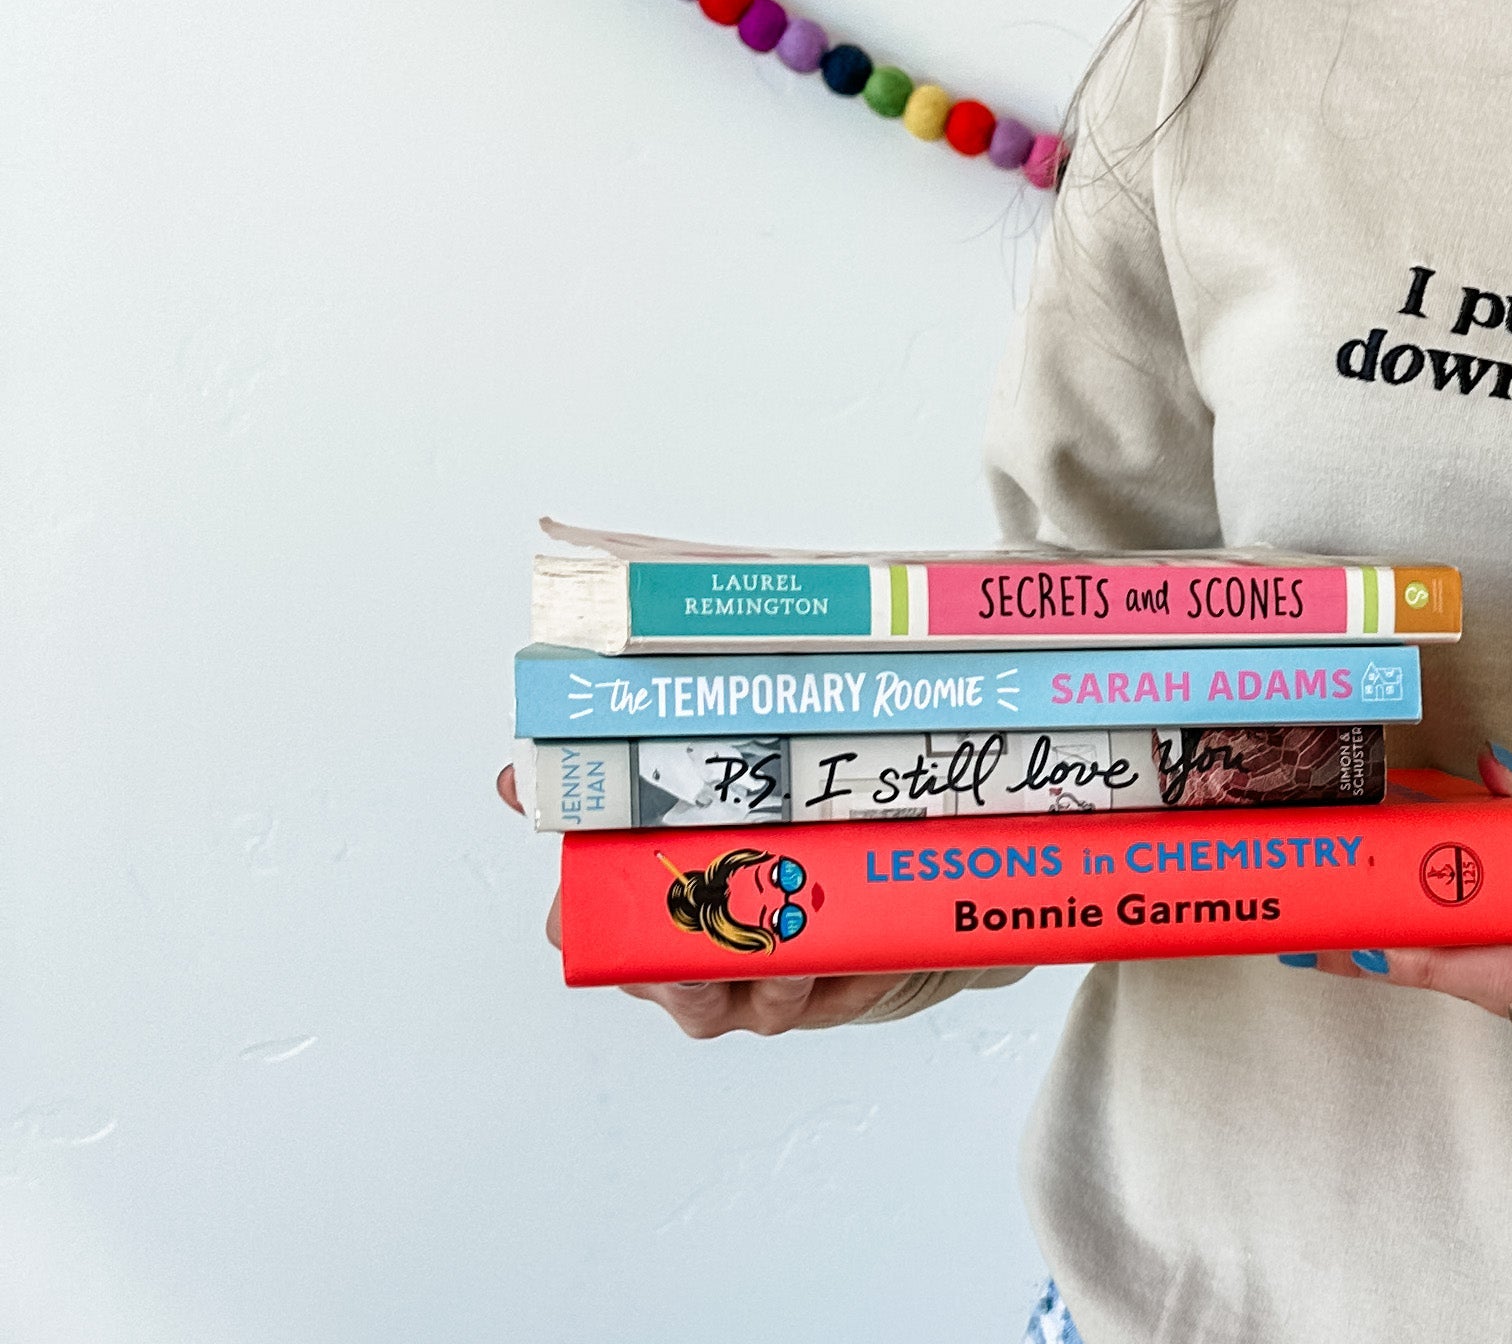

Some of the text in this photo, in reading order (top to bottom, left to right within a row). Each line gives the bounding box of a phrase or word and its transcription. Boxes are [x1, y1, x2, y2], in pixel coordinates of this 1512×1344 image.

[1398, 265, 1436, 318] I
[711, 573, 802, 592] LAUREL
[978, 572, 1304, 620] SECRETS and SCONES
[684, 597, 829, 616] REMINGTON
[595, 671, 984, 718] the TEMPORARY ROOMIE
[1051, 667, 1354, 706] SARAH ADAMS
[804, 752, 857, 808] I
[872, 732, 1005, 806] still
[1006, 734, 1139, 794] love
[1339, 732, 1351, 791] SIMON &
[1351, 726, 1365, 796] SCHUSTER
[561, 747, 581, 825] JENNY
[586, 759, 606, 812] HAN
[866, 845, 1062, 883] LESSONS
[1083, 847, 1114, 875] in
[1462, 861, 1476, 884] 125
[954, 894, 1281, 933] Bonnie Garmus
